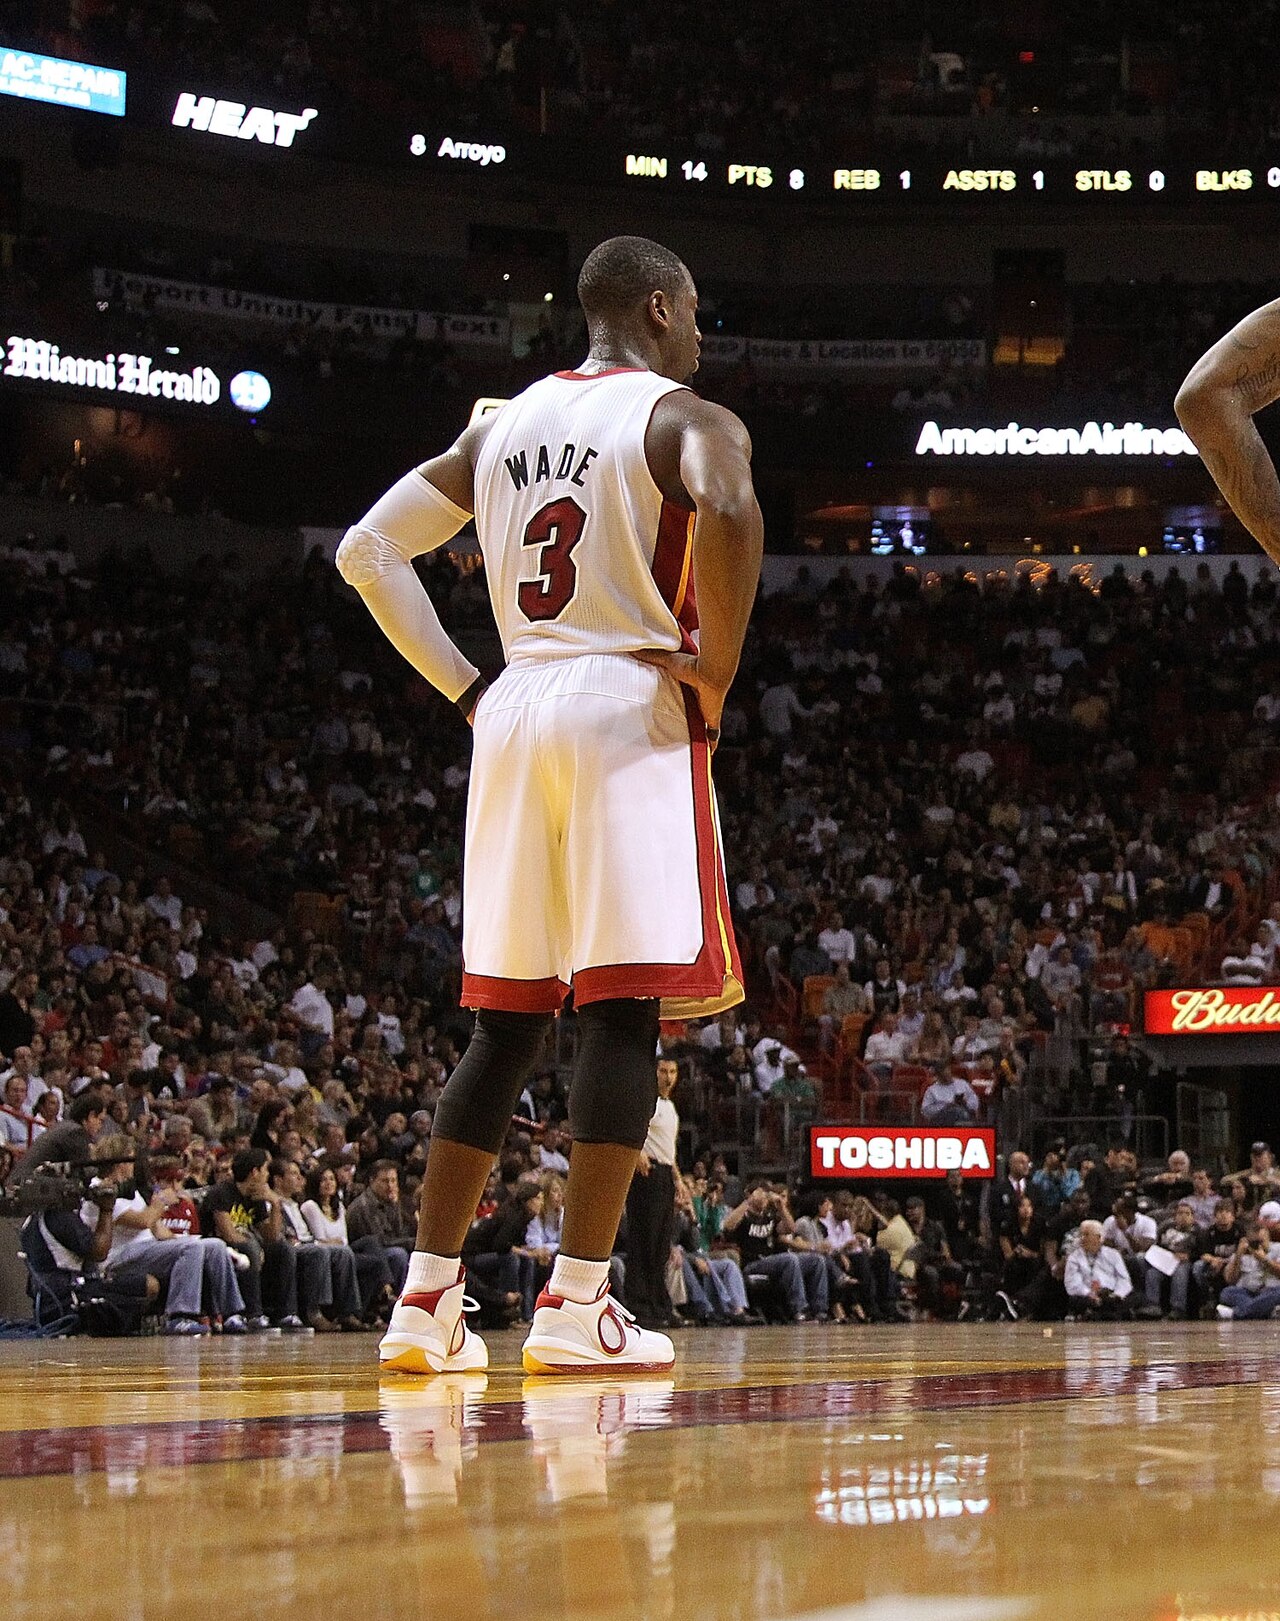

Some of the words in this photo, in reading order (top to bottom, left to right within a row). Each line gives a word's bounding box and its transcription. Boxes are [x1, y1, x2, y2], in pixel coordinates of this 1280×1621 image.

[172, 93, 318, 147] HEAT
[410, 135, 426, 156] 8
[438, 137, 506, 166] Arroyo
[626, 155, 668, 178] MIN
[682, 161, 708, 182] 14
[728, 165, 773, 188] PTS
[834, 170, 880, 190] REB
[900, 171, 911, 190] 1
[943, 170, 1016, 190] ASSTS
[1033, 171, 1044, 190] 1
[1076, 170, 1132, 191] STLS
[1149, 171, 1165, 191] 0
[1196, 169, 1253, 191] BLKS
[4, 336, 117, 391] Miami
[118, 353, 220, 405] Herald
[504, 443, 598, 491] WADE
[516, 493, 590, 624] 3
[816, 1137, 991, 1170] TOSHIBA
